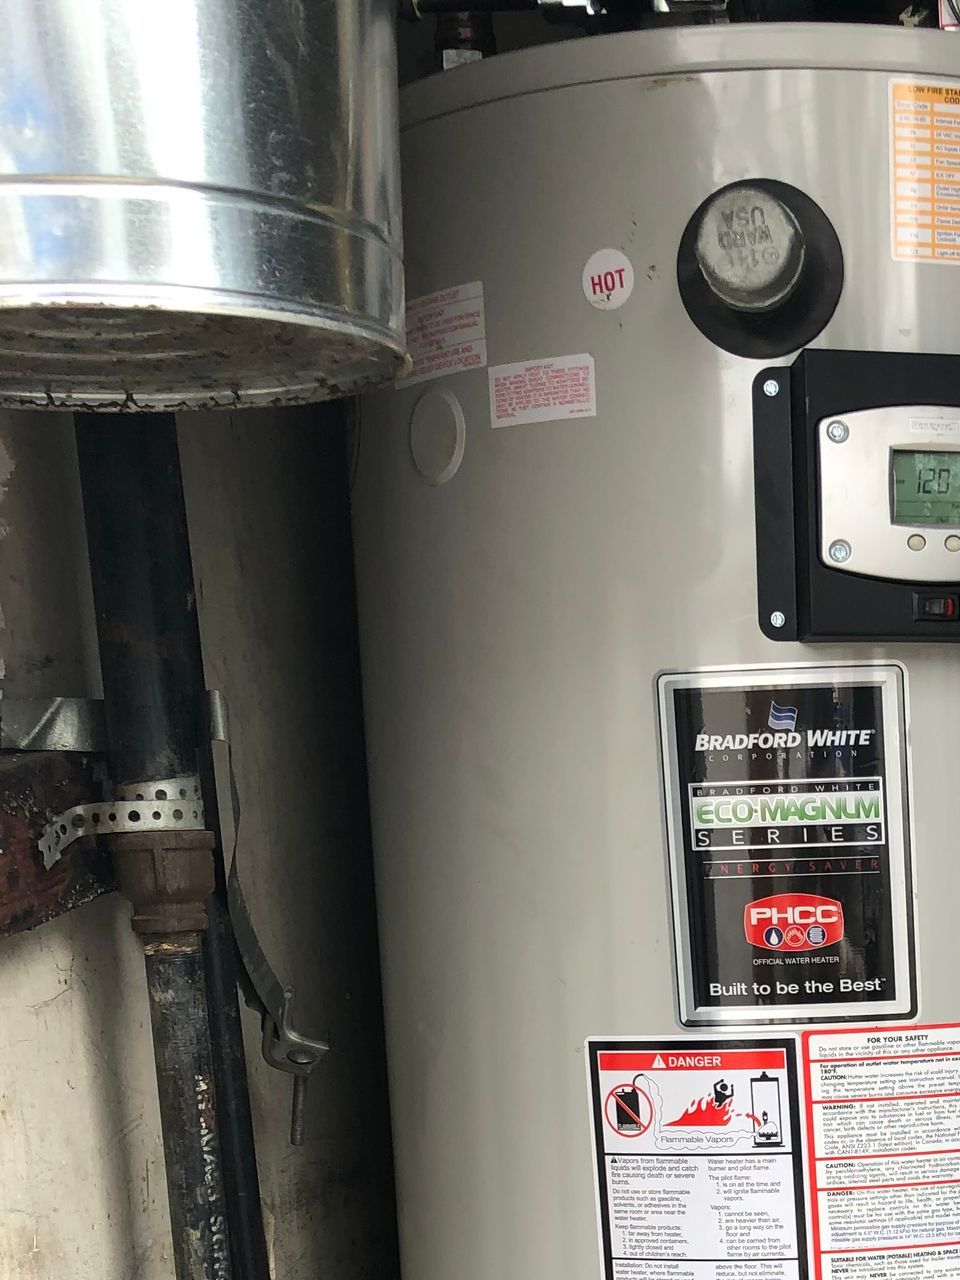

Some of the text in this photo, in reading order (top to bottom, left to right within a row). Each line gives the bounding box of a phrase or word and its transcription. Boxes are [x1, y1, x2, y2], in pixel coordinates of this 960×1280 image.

[721, 206, 765, 230] USA
[590, 269, 625, 295] HOT
[917, 468, 951, 494] 120
[695, 732, 801, 751] BRADFORD
[708, 750, 858, 762] CORPORATION
[697, 783, 875, 797] BRADFORD WHITE
[698, 825, 878, 846] SERIES
[705, 859, 879, 874] ENERGY SAVER
[750, 905, 839, 926] PHCC
[753, 956, 839, 966] OFFICIAL WATER HEATER
[709, 983, 748, 997] Built
[752, 983, 771, 995] to
[776, 982, 799, 994] be
[804, 980, 834, 994] the
[669, 1056, 721, 1068] DANGER
[705, 1136, 734, 1144] Vapors
